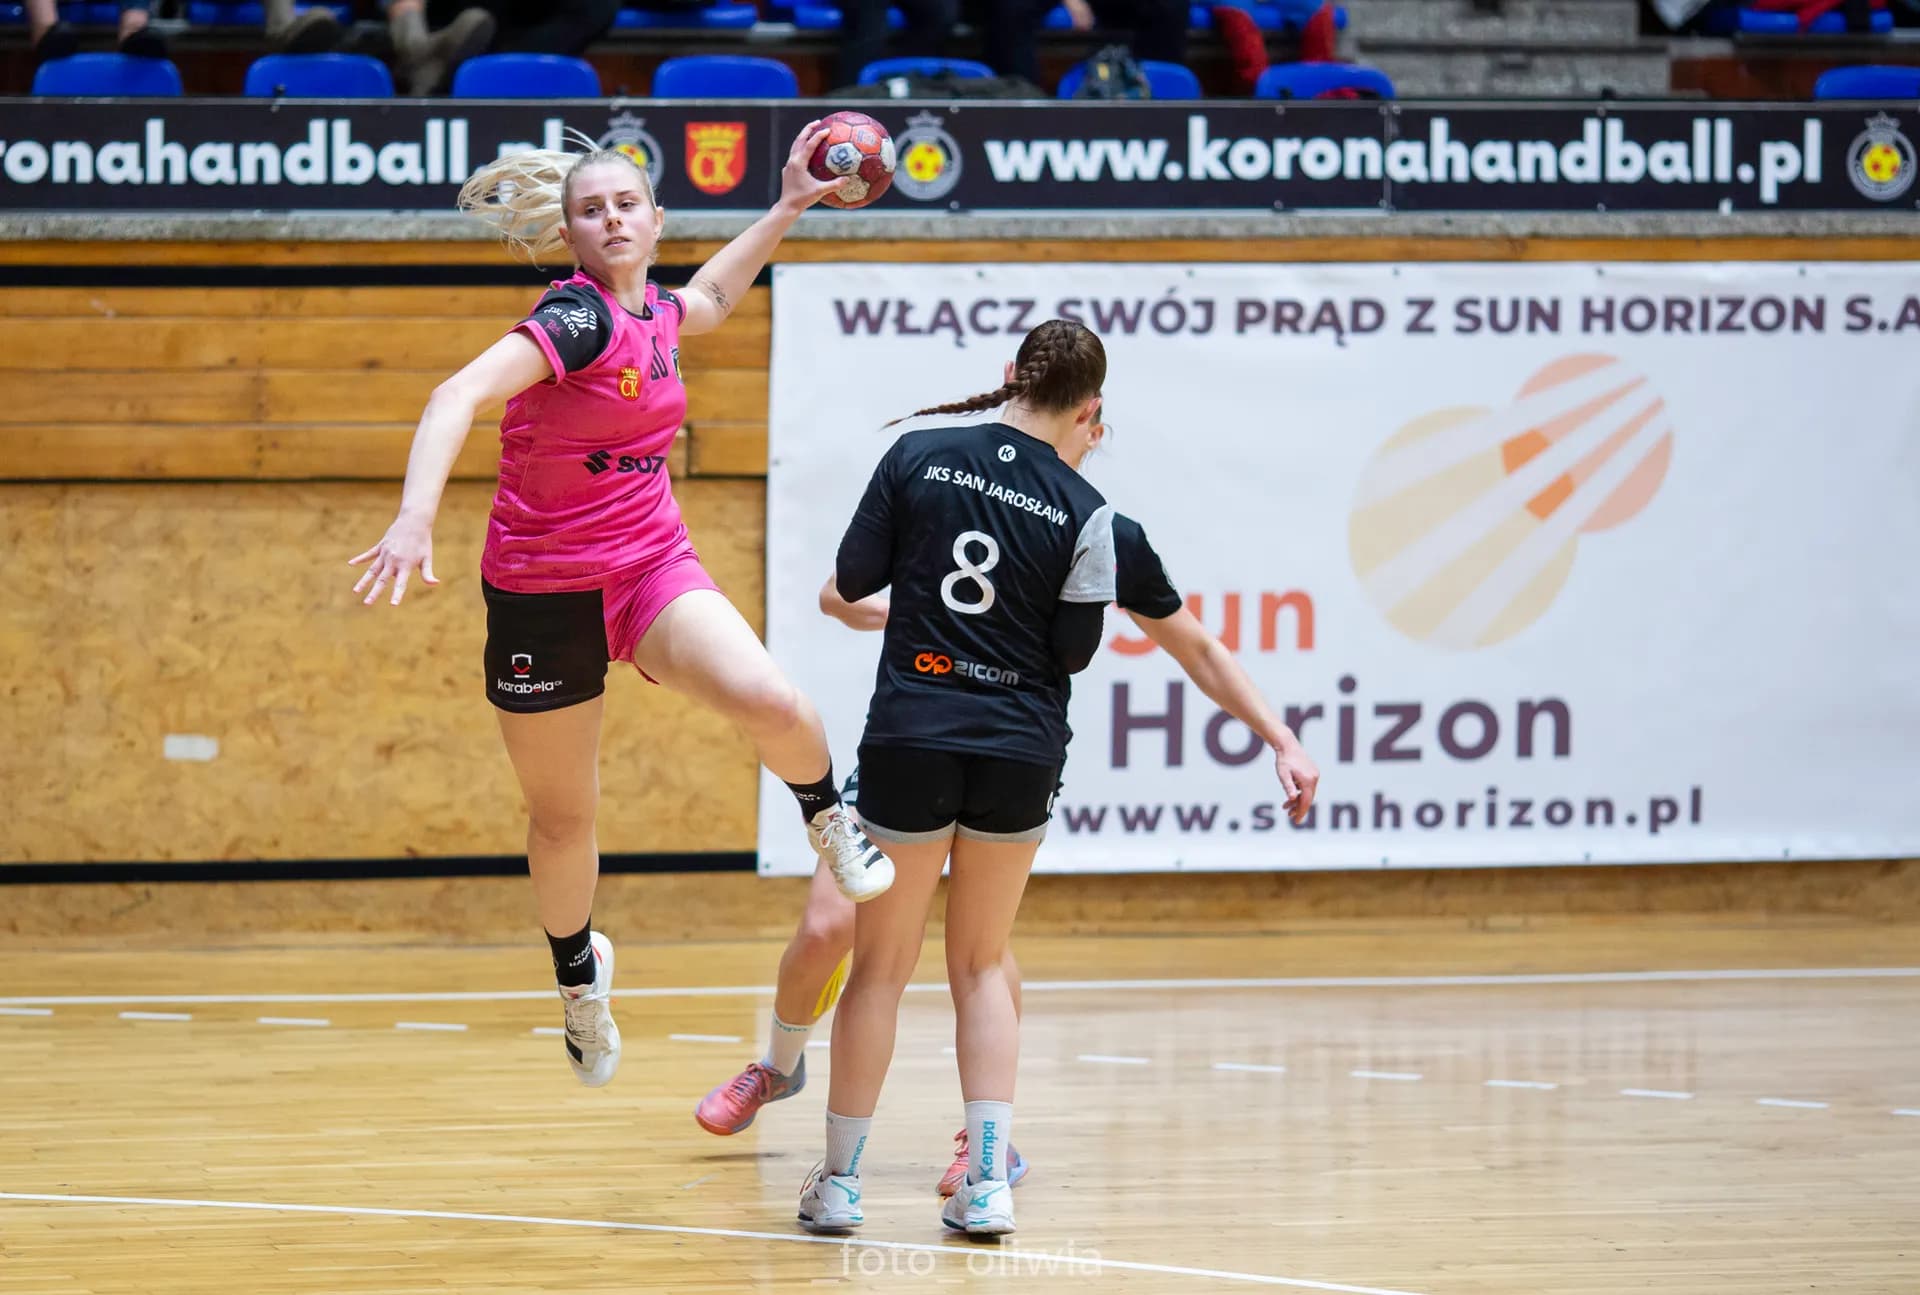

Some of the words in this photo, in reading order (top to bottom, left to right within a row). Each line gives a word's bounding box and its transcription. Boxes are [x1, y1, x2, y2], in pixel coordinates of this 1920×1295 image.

[984, 116, 1822, 203] www.koronahandball.pl
[834, 298, 1037, 349] WŁĄCZ
[1055, 286, 1216, 337] SWÓJ
[1236, 298, 1386, 348] PRĄD
[1405, 297, 1437, 333] Z
[1454, 296, 1561, 335] SUN
[1581, 296, 1825, 335] HORIZON
[923, 465, 951, 482] JKS
[952, 470, 985, 492] SAN
[985, 482, 1068, 526] JAROSŁAW
[940, 530, 1000, 614] 8
[497, 678, 554, 694] karabela
[1109, 674, 1572, 769] Horizon
[1061, 787, 1703, 834] www.sunhorizon.pl
[979, 1120, 998, 1181] Kempa
